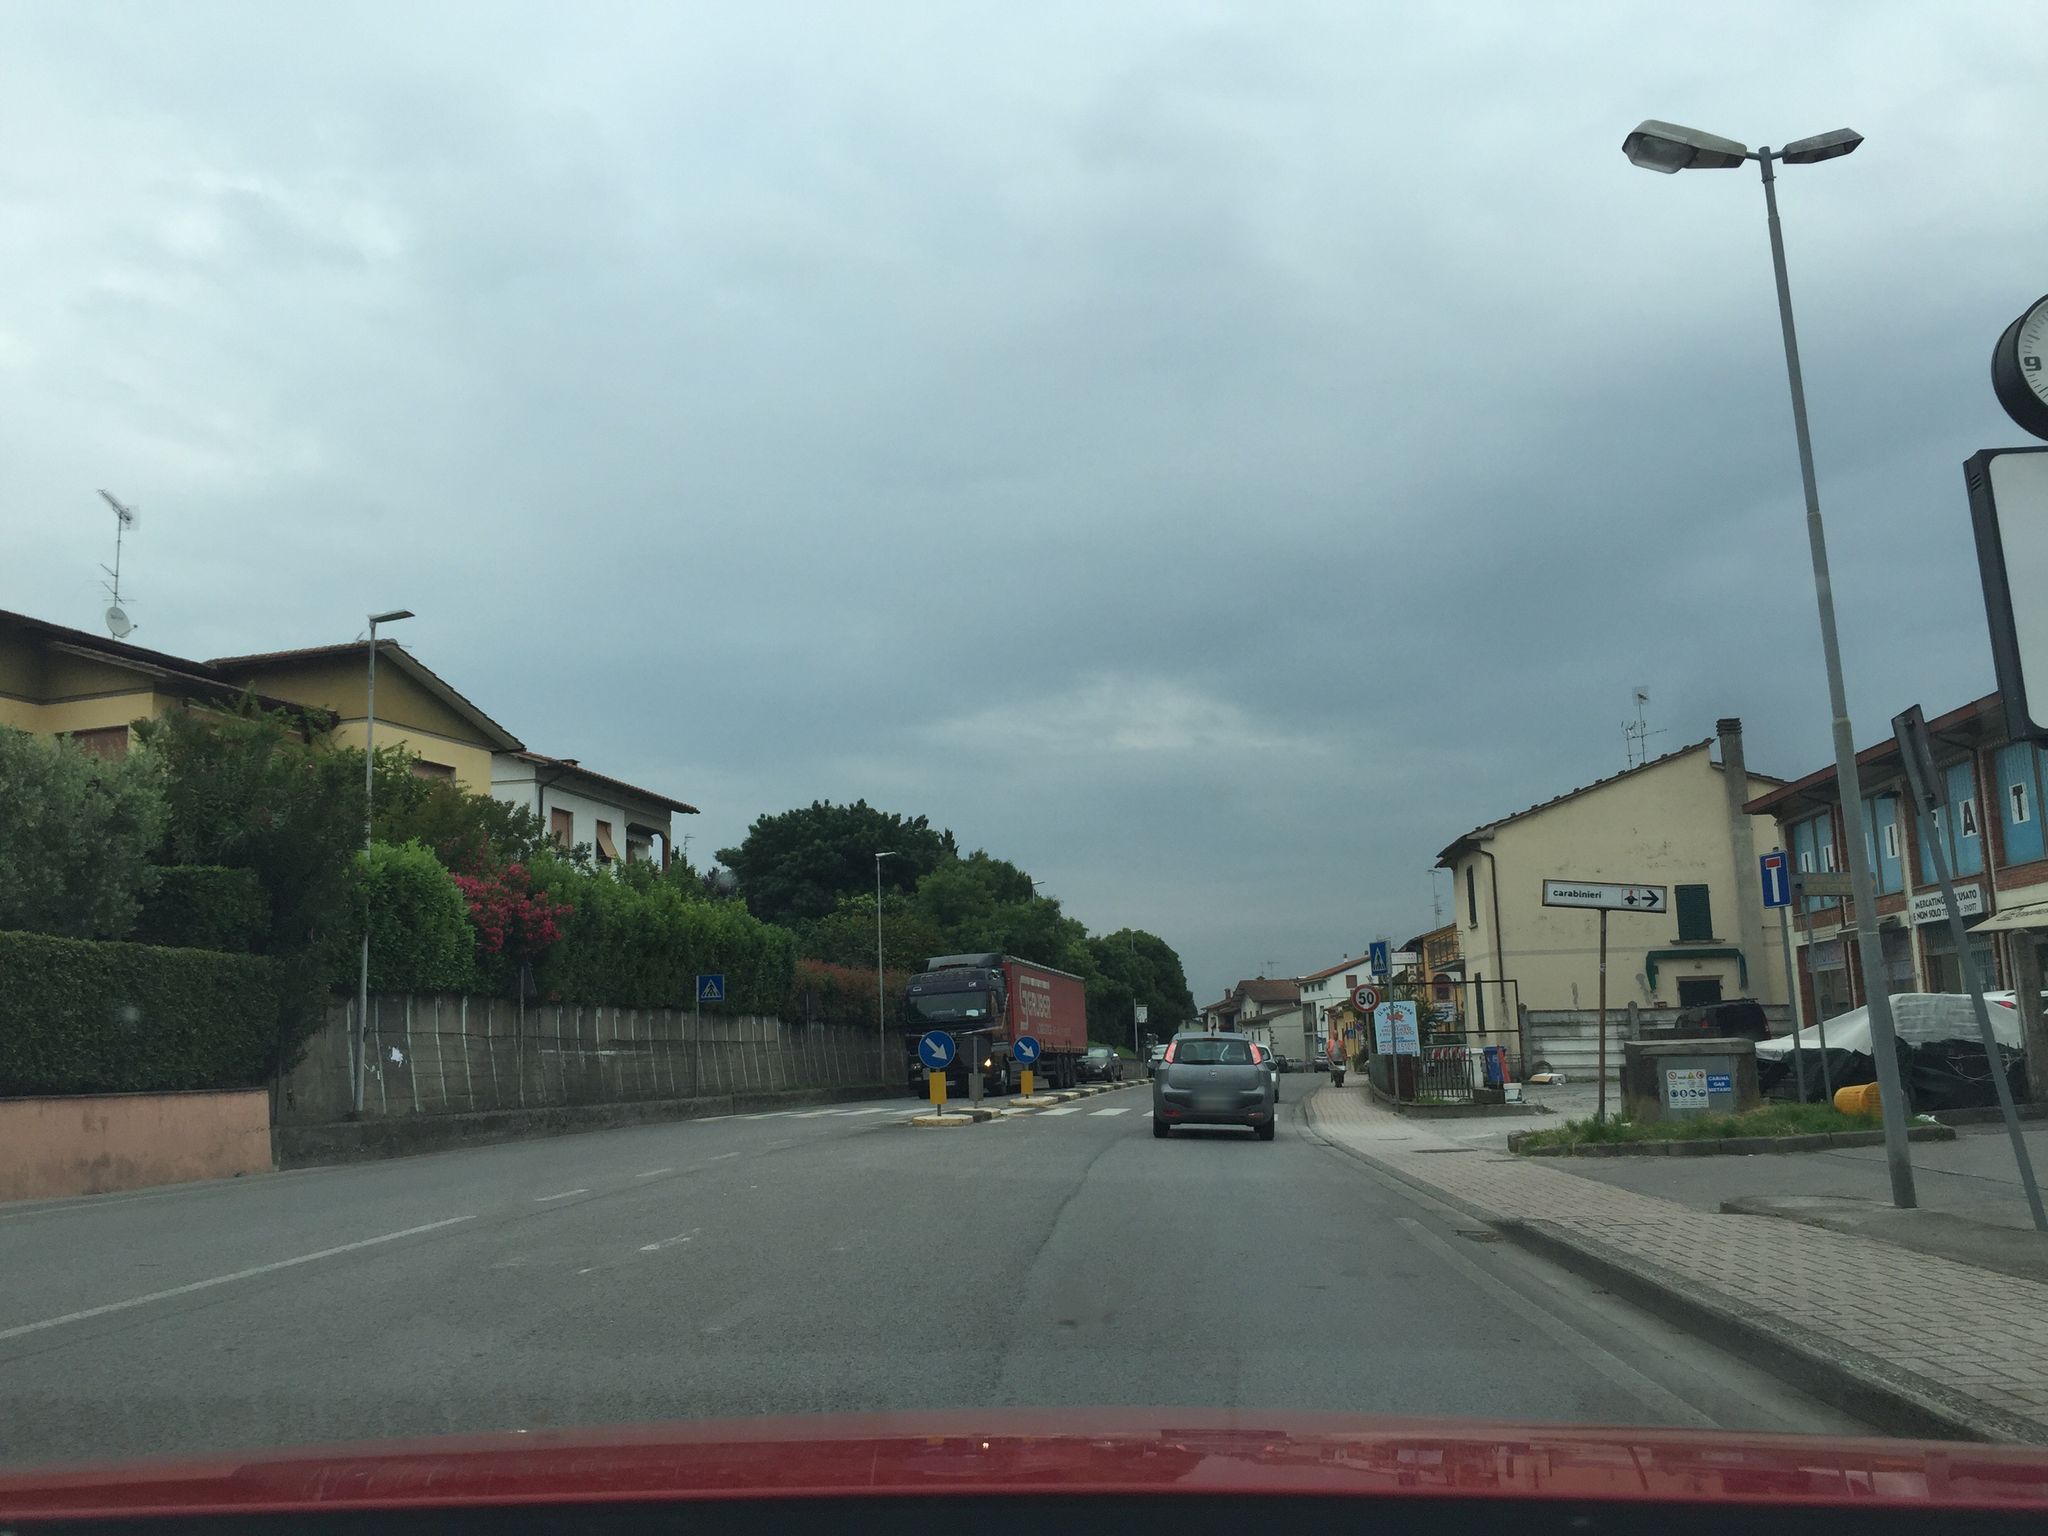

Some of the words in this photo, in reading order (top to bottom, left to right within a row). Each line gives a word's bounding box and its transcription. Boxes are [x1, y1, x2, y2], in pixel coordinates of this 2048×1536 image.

[2024, 356, 2042, 372] 9
[1963, 801, 1977, 836] A
[2012, 784, 2023, 821] T
[1552, 889, 1602, 900] carabinieri
[1915, 896, 1945, 910] MERCATINO
[1917, 910, 1928, 920] NON
[1928, 908, 1942, 918] SOLO
[1358, 991, 1374, 1005] 50
